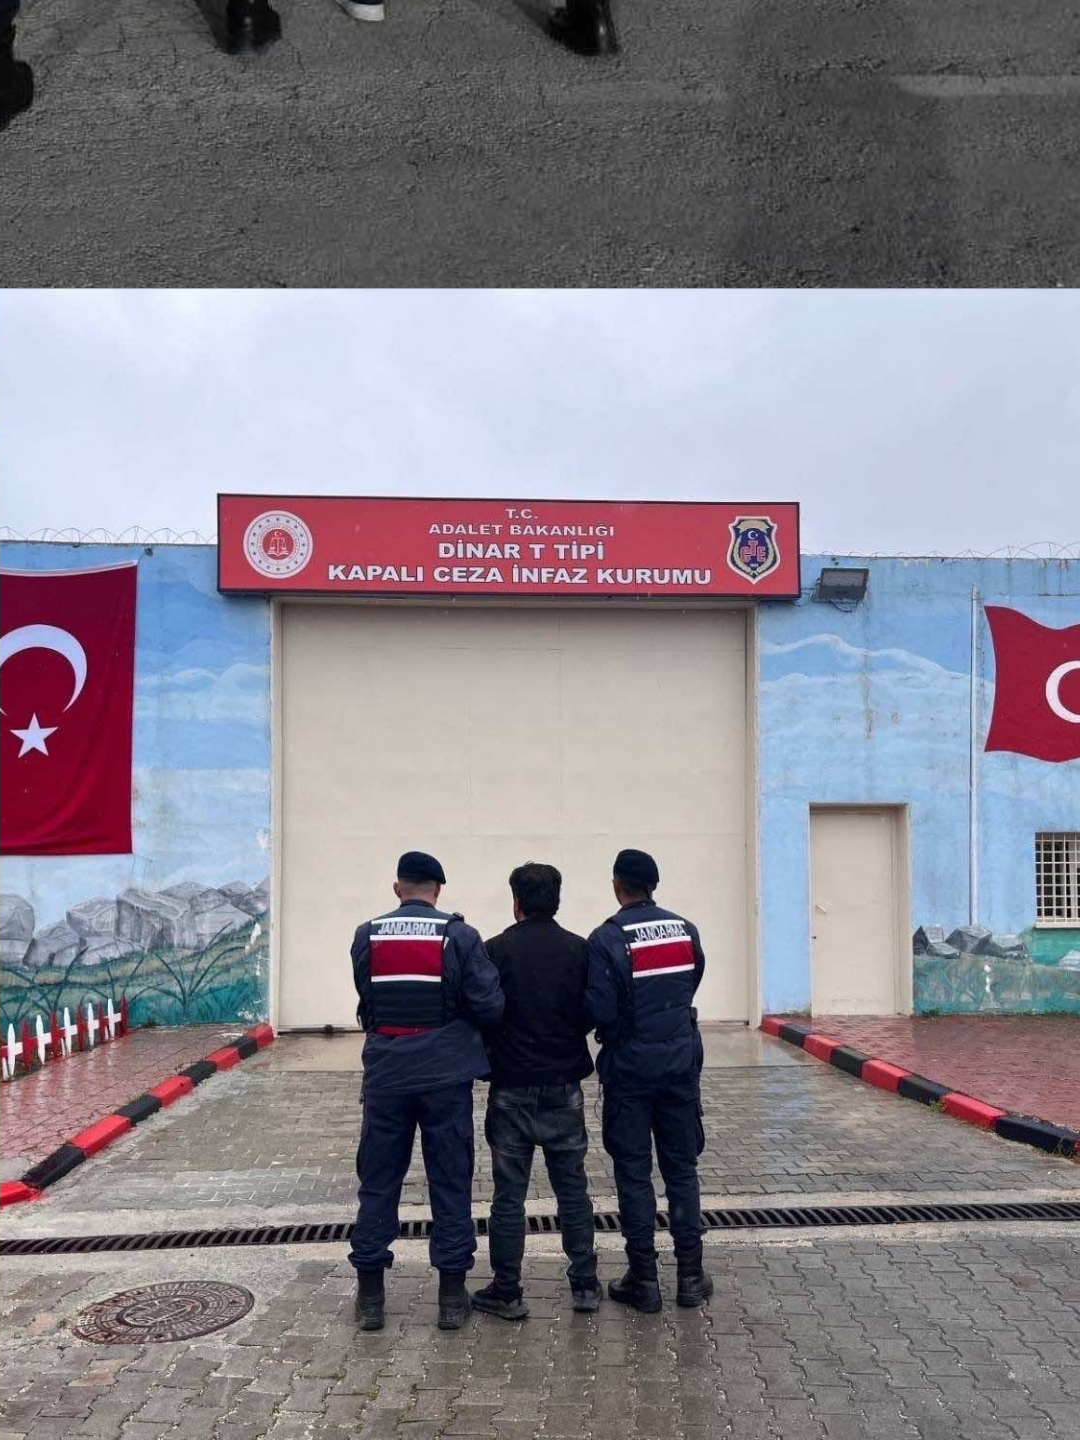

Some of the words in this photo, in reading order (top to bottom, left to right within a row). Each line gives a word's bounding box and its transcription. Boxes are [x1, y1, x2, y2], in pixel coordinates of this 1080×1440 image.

[505, 509, 538, 519] T.C.
[428, 523, 502, 535] ADALET
[509, 523, 614, 537] BAKANLIĞI
[438, 539, 520, 559] DİNAR
[529, 543, 545, 560] T
[553, 540, 604, 560] TİPİ
[328, 564, 424, 582] KAPALI
[433, 566, 503, 583] CEZA
[512, 563, 588, 584] İNFAZ
[597, 568, 711, 584] KURUMU
[378, 922, 437, 935] JANDARMA
[635, 923, 687, 942] JANDARMA
